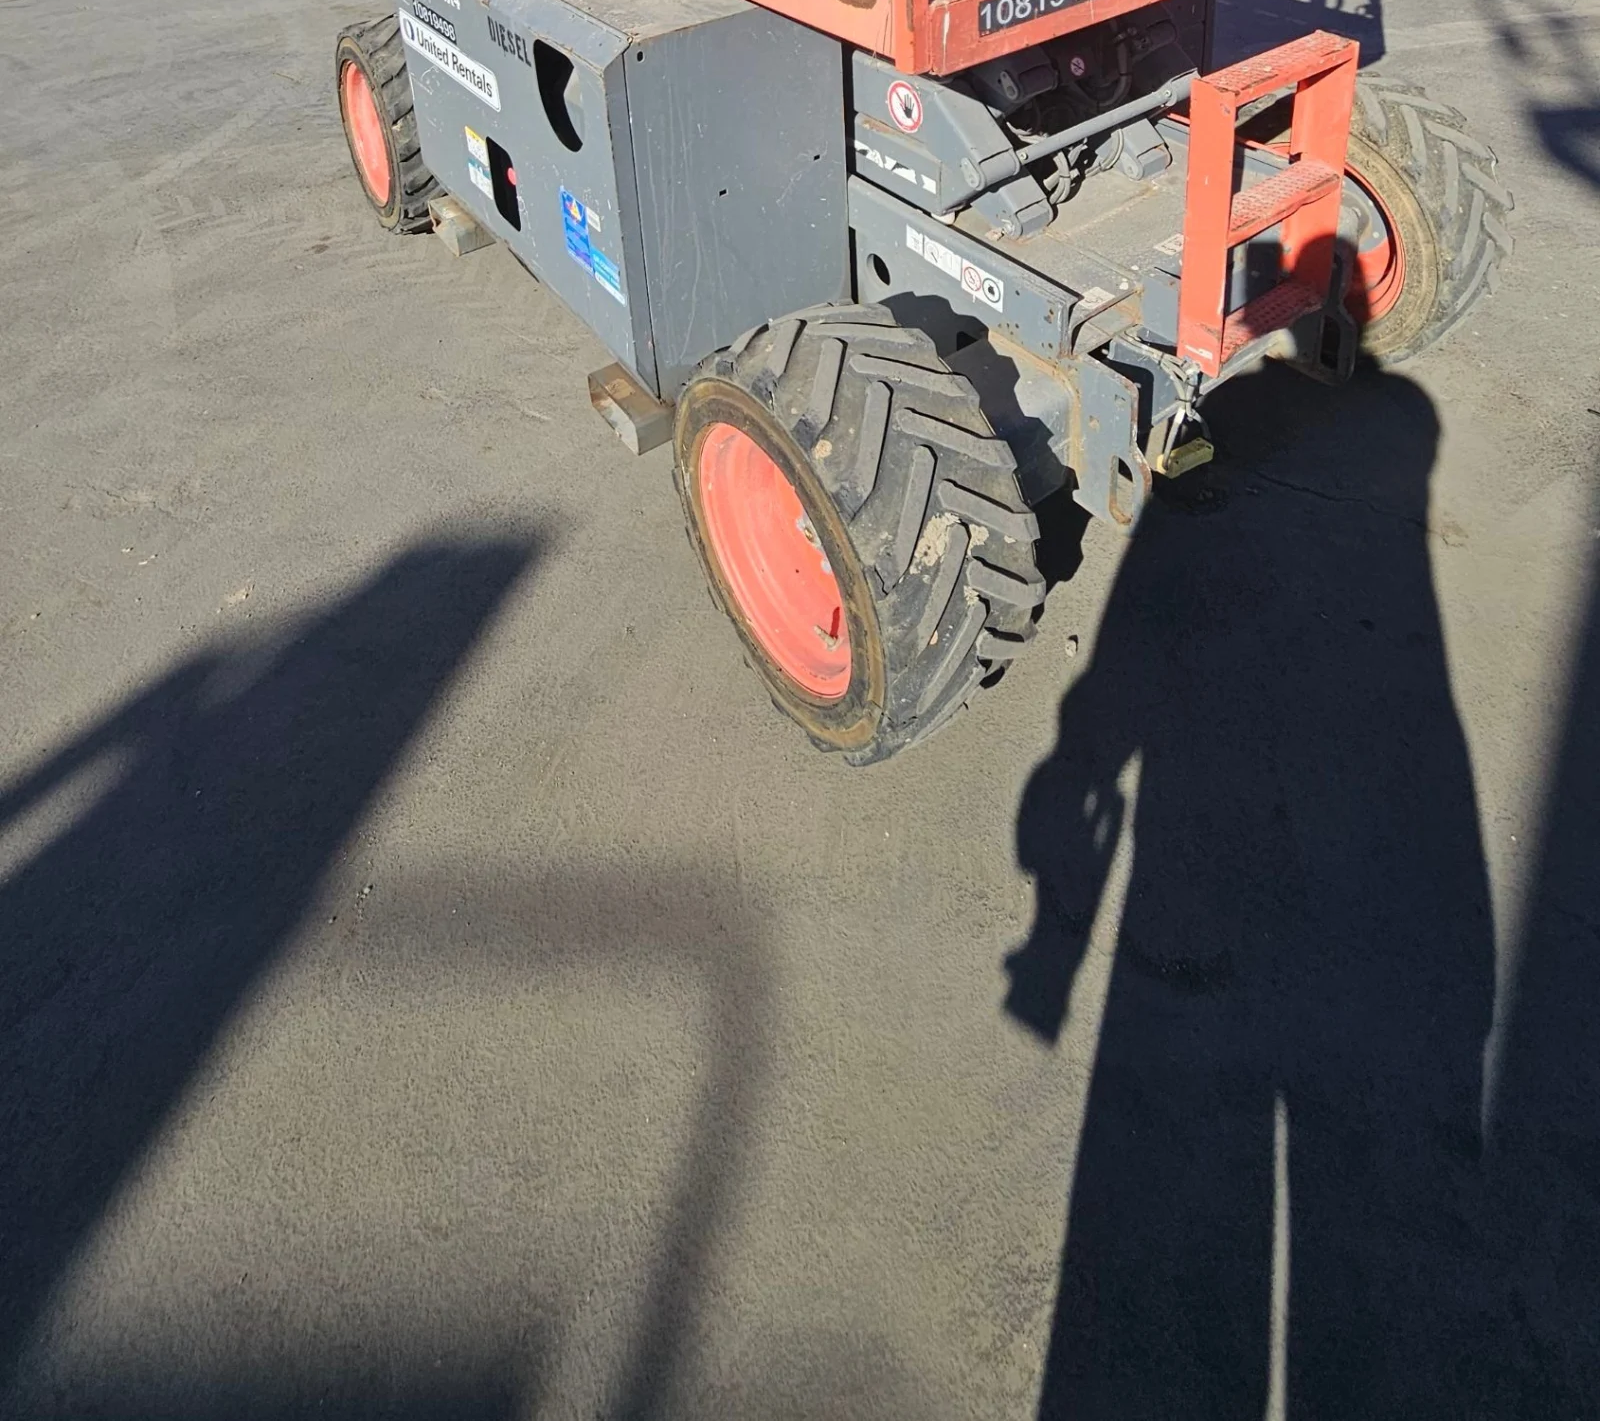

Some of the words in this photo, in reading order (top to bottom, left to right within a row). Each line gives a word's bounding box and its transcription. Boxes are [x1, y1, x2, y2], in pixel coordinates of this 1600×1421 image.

[412, 1, 456, 41] 10819498
[487, 16, 532, 67] DIESEL
[416, 26, 449, 68] United
[451, 52, 493, 98] Rentals
